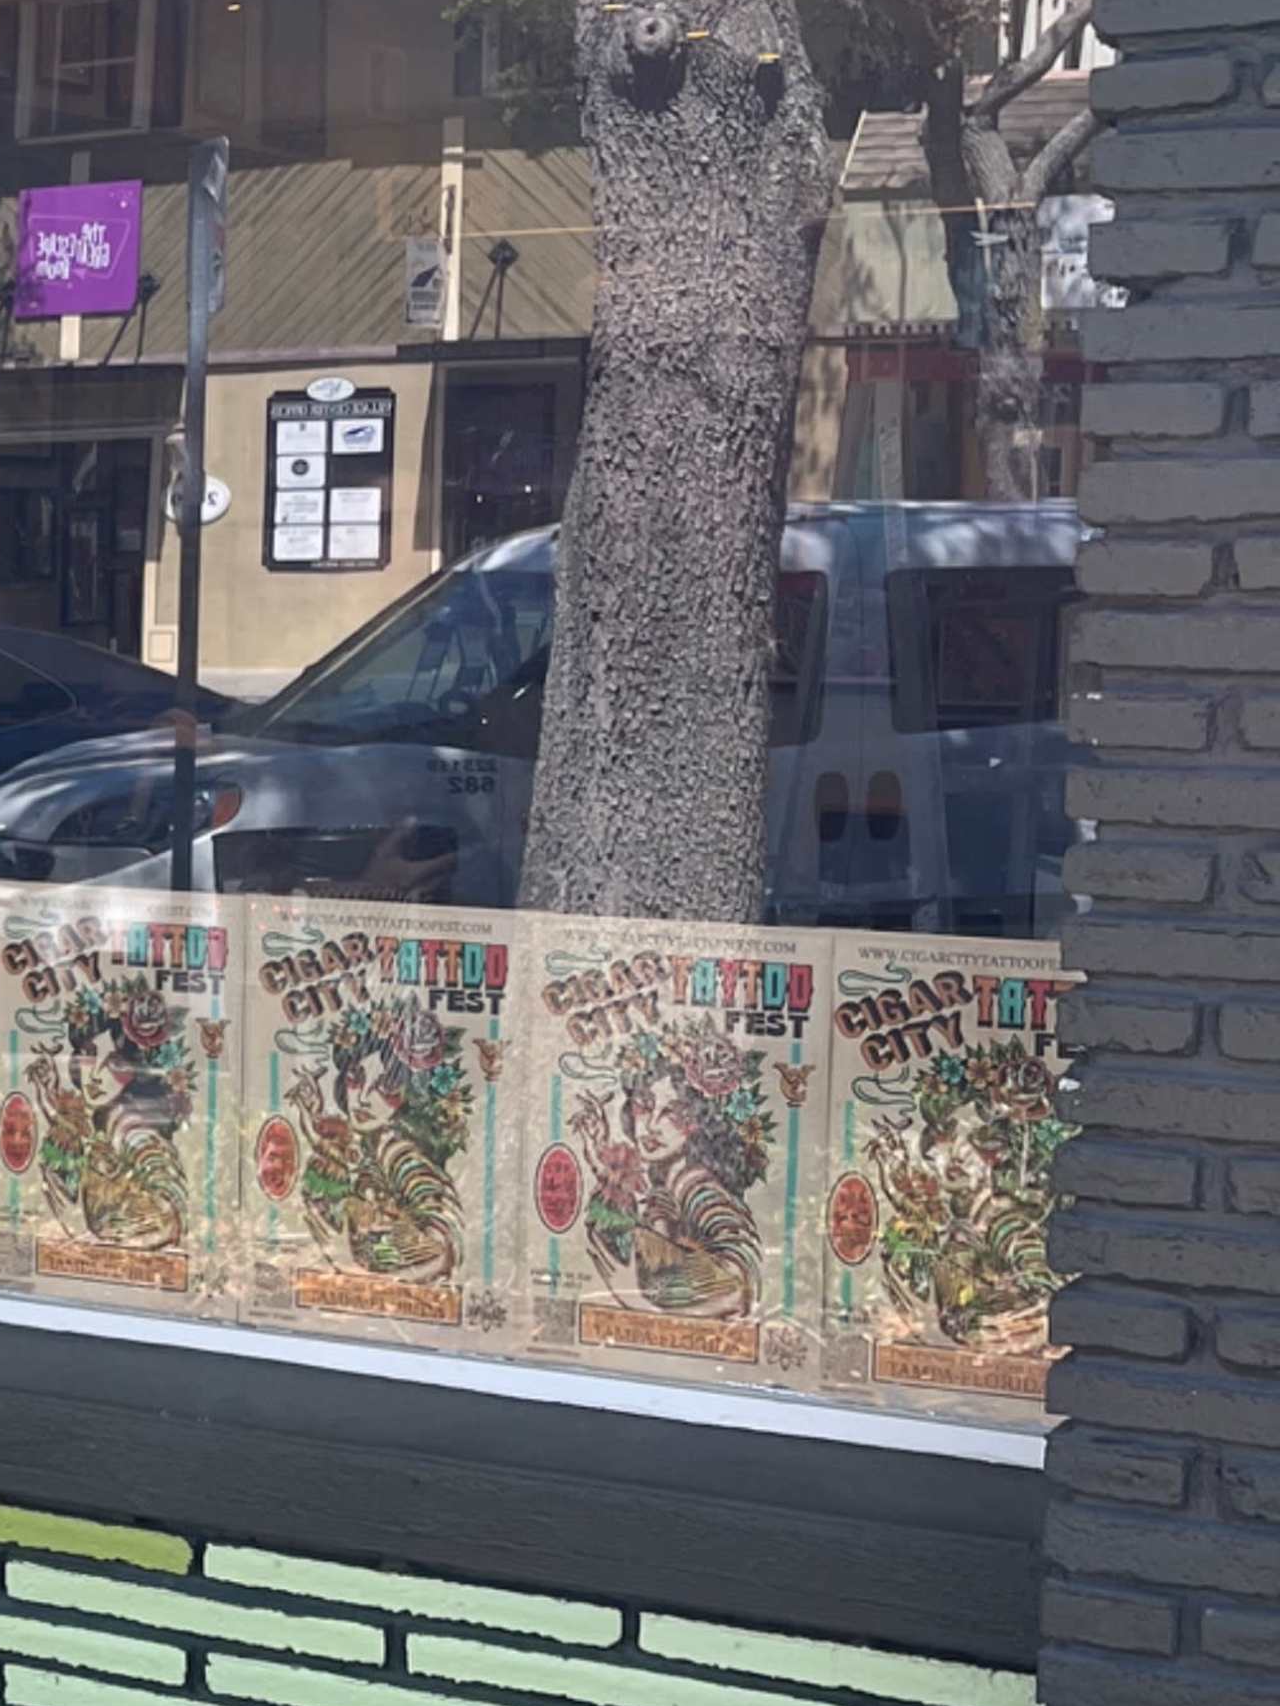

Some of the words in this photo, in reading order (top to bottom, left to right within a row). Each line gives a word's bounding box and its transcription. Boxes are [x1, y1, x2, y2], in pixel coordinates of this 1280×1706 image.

[2, 916, 108, 975] CIGAR
[257, 932, 376, 995] CIGAR
[375, 936, 508, 990] TATTOO
[21, 951, 101, 1004] CITY
[155, 970, 225, 995] FEST
[282, 971, 370, 1024] CITY
[429, 990, 505, 1015] FEST
[541, 950, 674, 1016] CIGAR
[668, 956, 814, 1012] TATTOO
[835, 969, 974, 1038] CIGAR
[974, 975, 1075, 1029] TAT
[564, 992, 662, 1048] CITY
[726, 1010, 809, 1039] FEST
[860, 1011, 965, 1073] CITY
